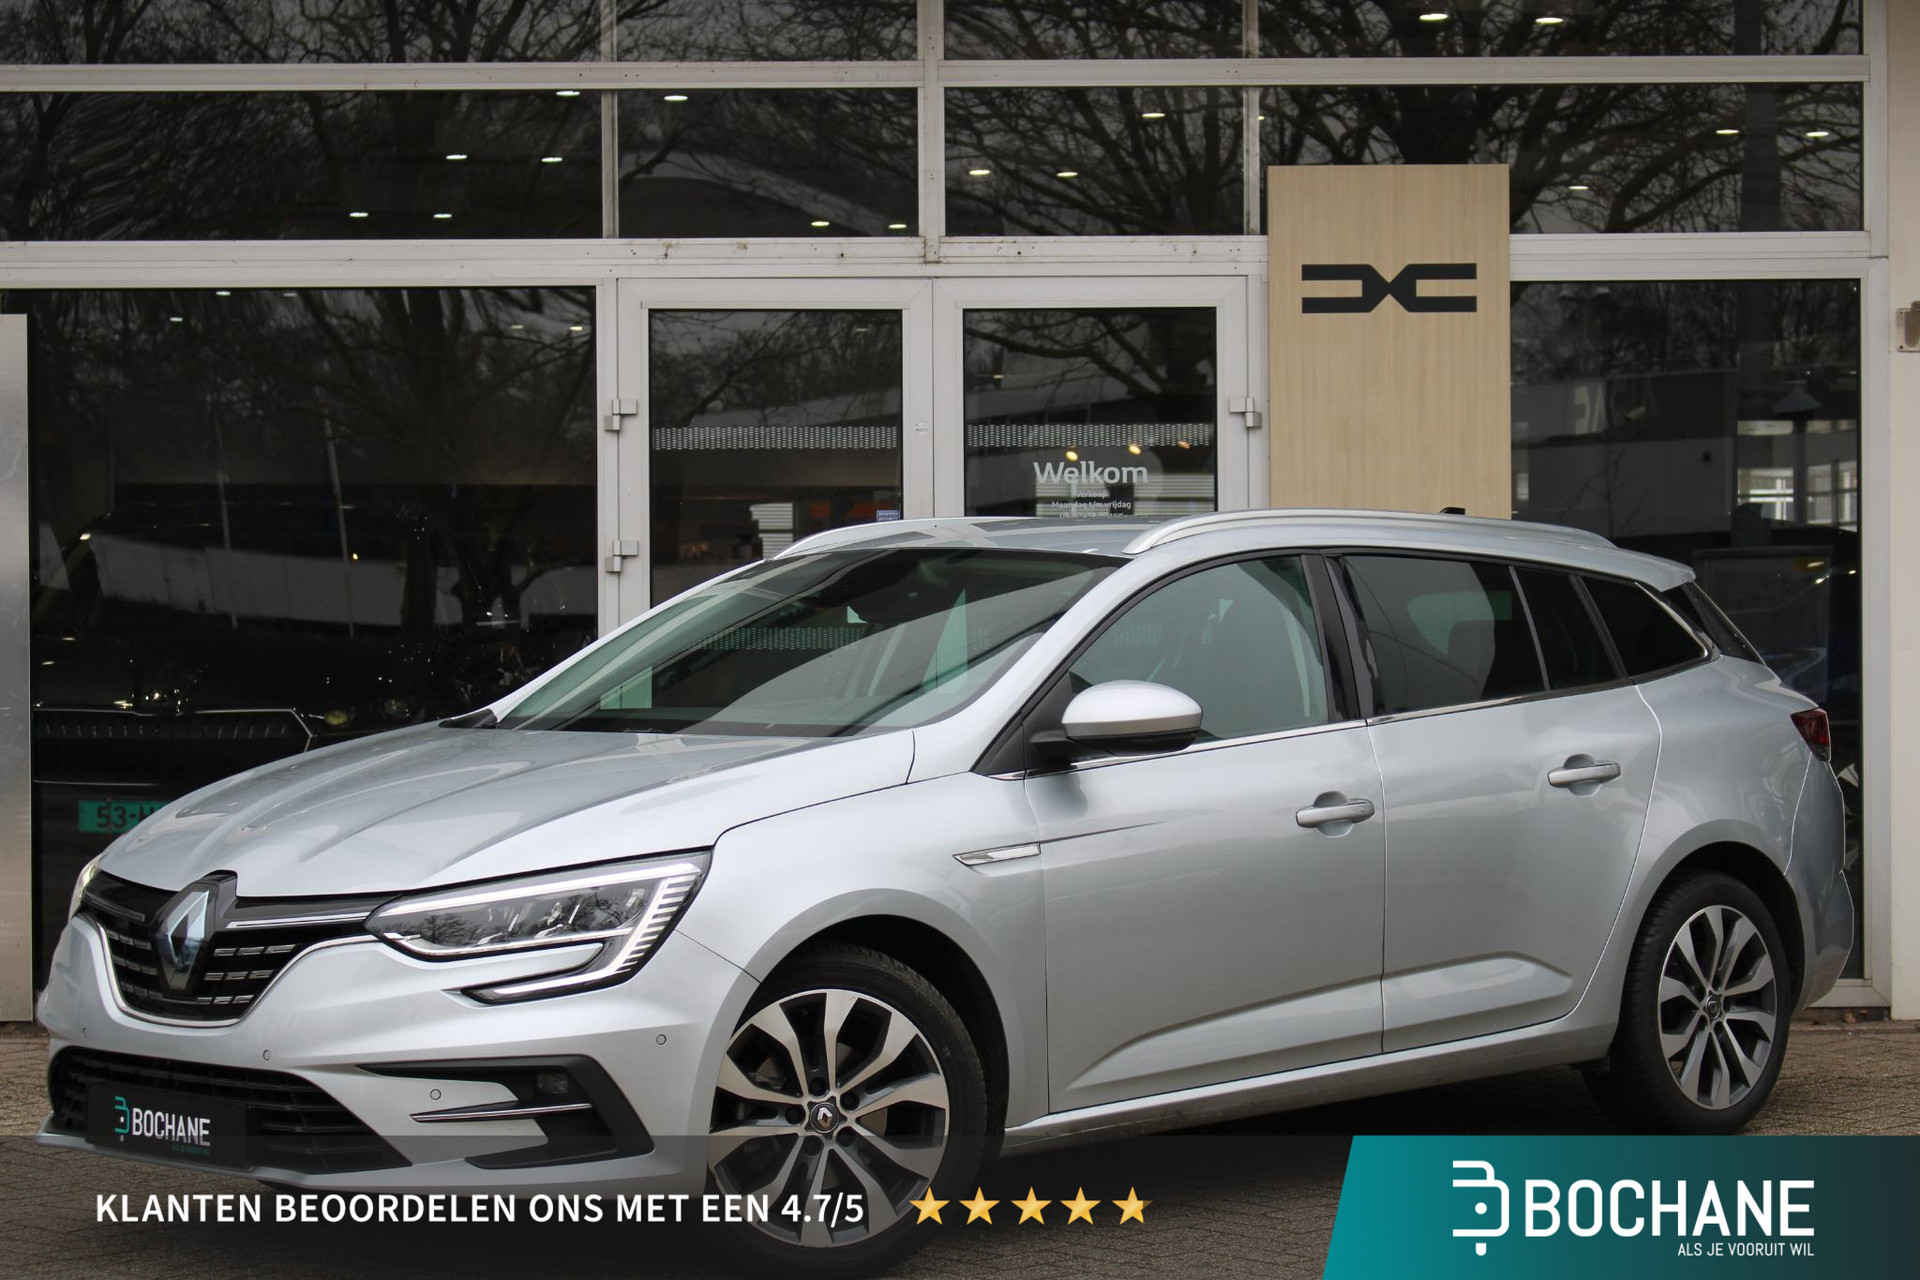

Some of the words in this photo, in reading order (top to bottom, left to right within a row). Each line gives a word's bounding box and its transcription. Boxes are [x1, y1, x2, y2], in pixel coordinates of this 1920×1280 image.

[1033, 461, 1148, 484] Welkom
[1076, 490, 1109, 499] Verkoop
[1051, 501, 1088, 510] Maandag
[1105, 501, 1131, 510] vrijdag
[132, 1107, 211, 1147] BOCHANE
